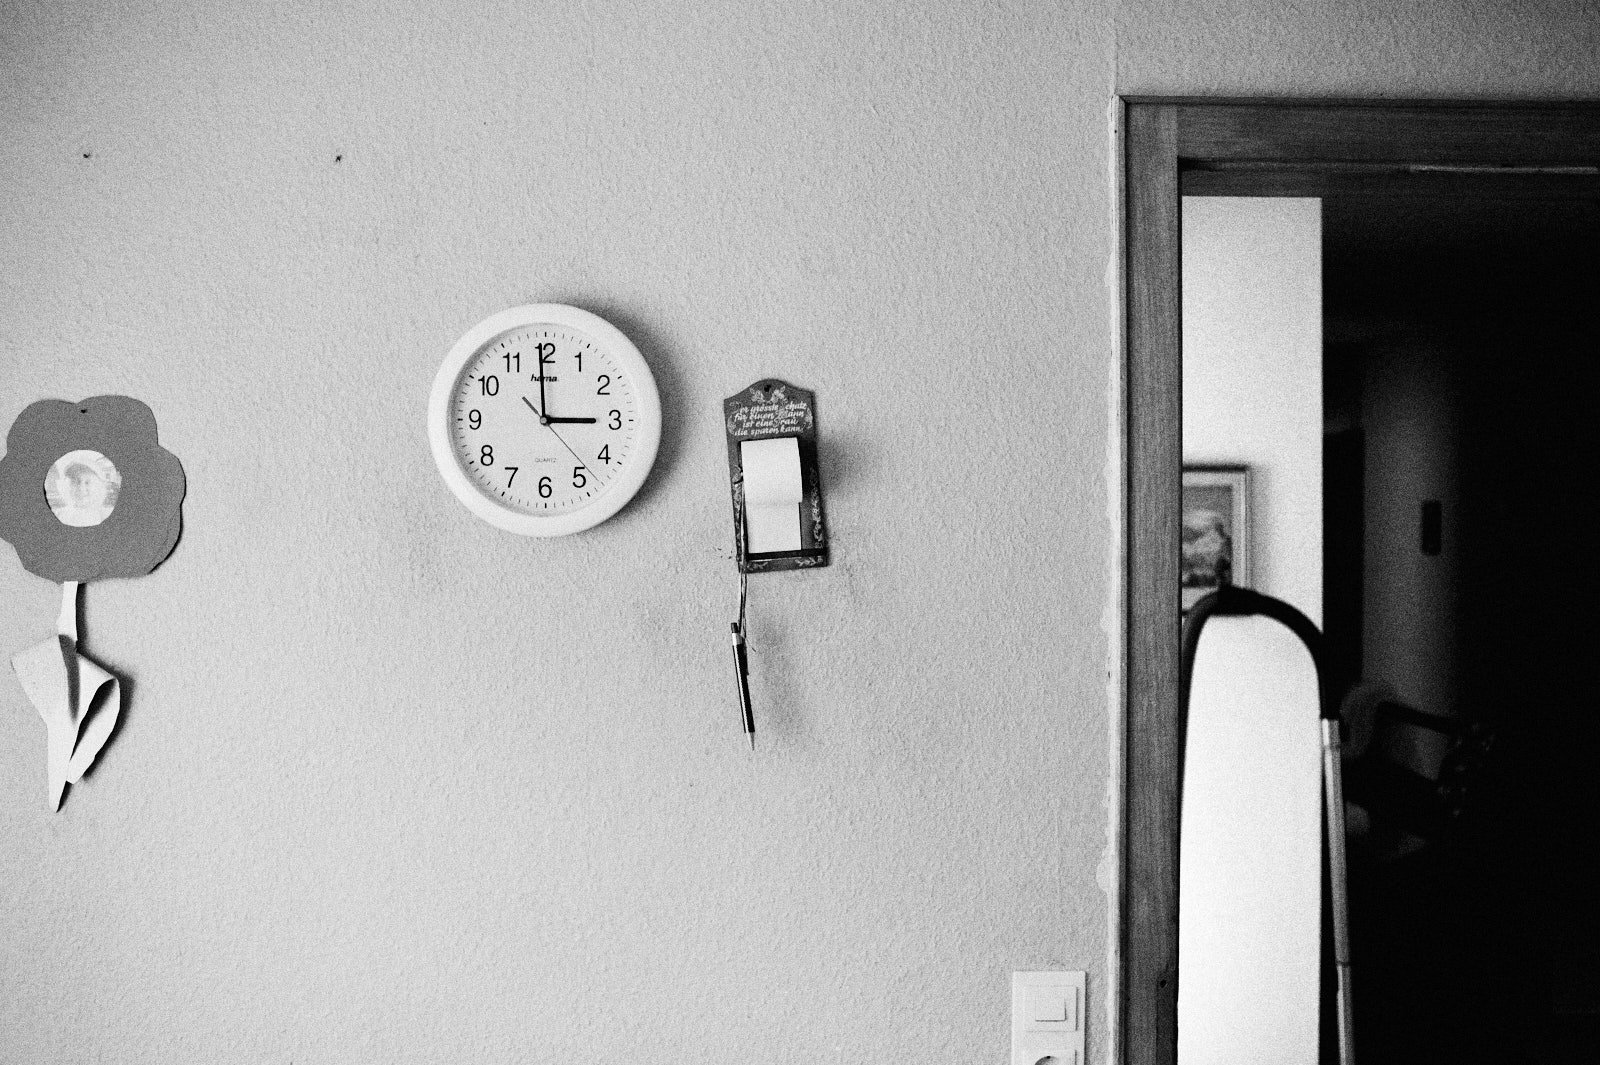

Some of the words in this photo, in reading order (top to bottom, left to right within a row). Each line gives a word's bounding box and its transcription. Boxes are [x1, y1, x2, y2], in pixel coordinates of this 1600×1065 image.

[503, 352, 520, 373] 11
[575, 352, 582, 372] 1
[478, 375, 499, 396] 10
[597, 374, 610, 395] 2
[469, 409, 482, 430] 9
[608, 409, 622, 430] 3
[480, 444, 494, 466] 8
[597, 444, 611, 465] 4
[504, 467, 518, 488] 7
[538, 476, 552, 498] 6
[572, 467, 586, 488] 5
